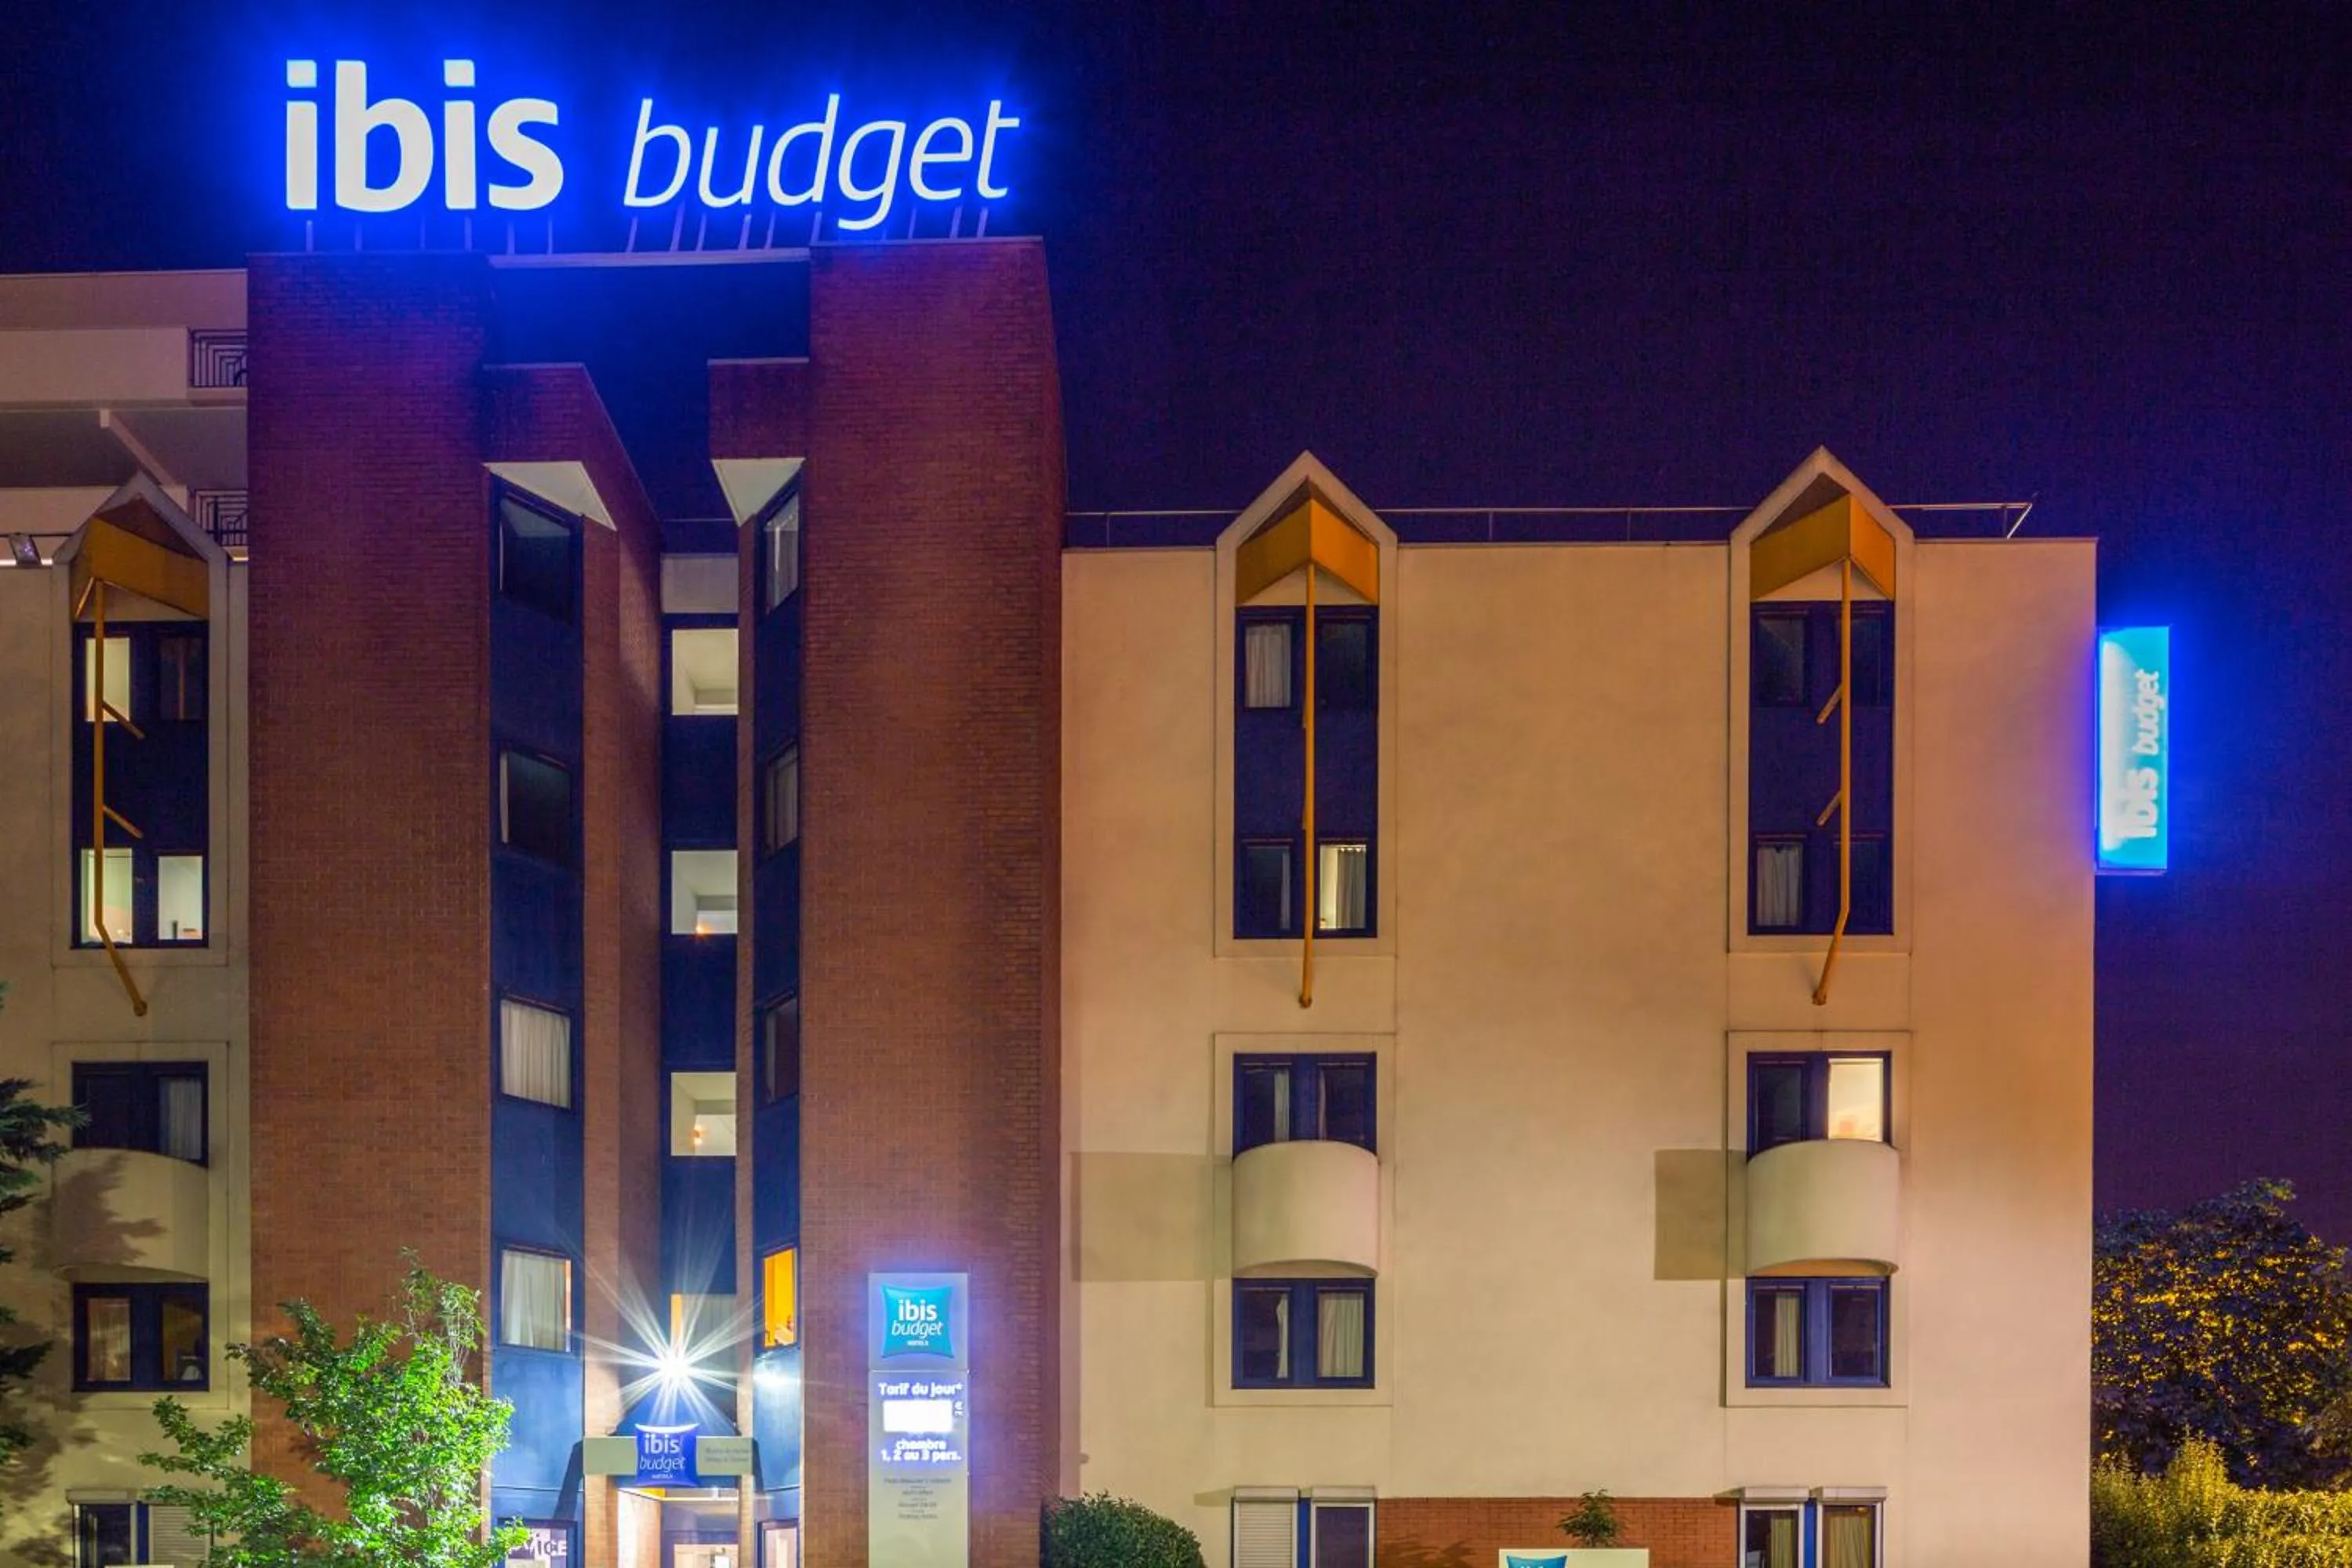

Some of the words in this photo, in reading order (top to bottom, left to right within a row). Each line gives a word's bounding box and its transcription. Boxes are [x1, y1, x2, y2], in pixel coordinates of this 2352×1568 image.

[286, 60, 564, 212] ibis
[623, 94, 1019, 230] budget
[2132, 668, 2165, 756] budget
[2117, 768, 2158, 839] ibis
[898, 1298, 938, 1321] ibis
[891, 1319, 945, 1339] budget
[877, 1382, 910, 1396] Tarif
[911, 1382, 929, 1396] du
[644, 1432, 681, 1454] ibis
[895, 1437, 947, 1450] chambre
[639, 1454, 686, 1473] budget
[903, 1450, 920, 1461] ou
